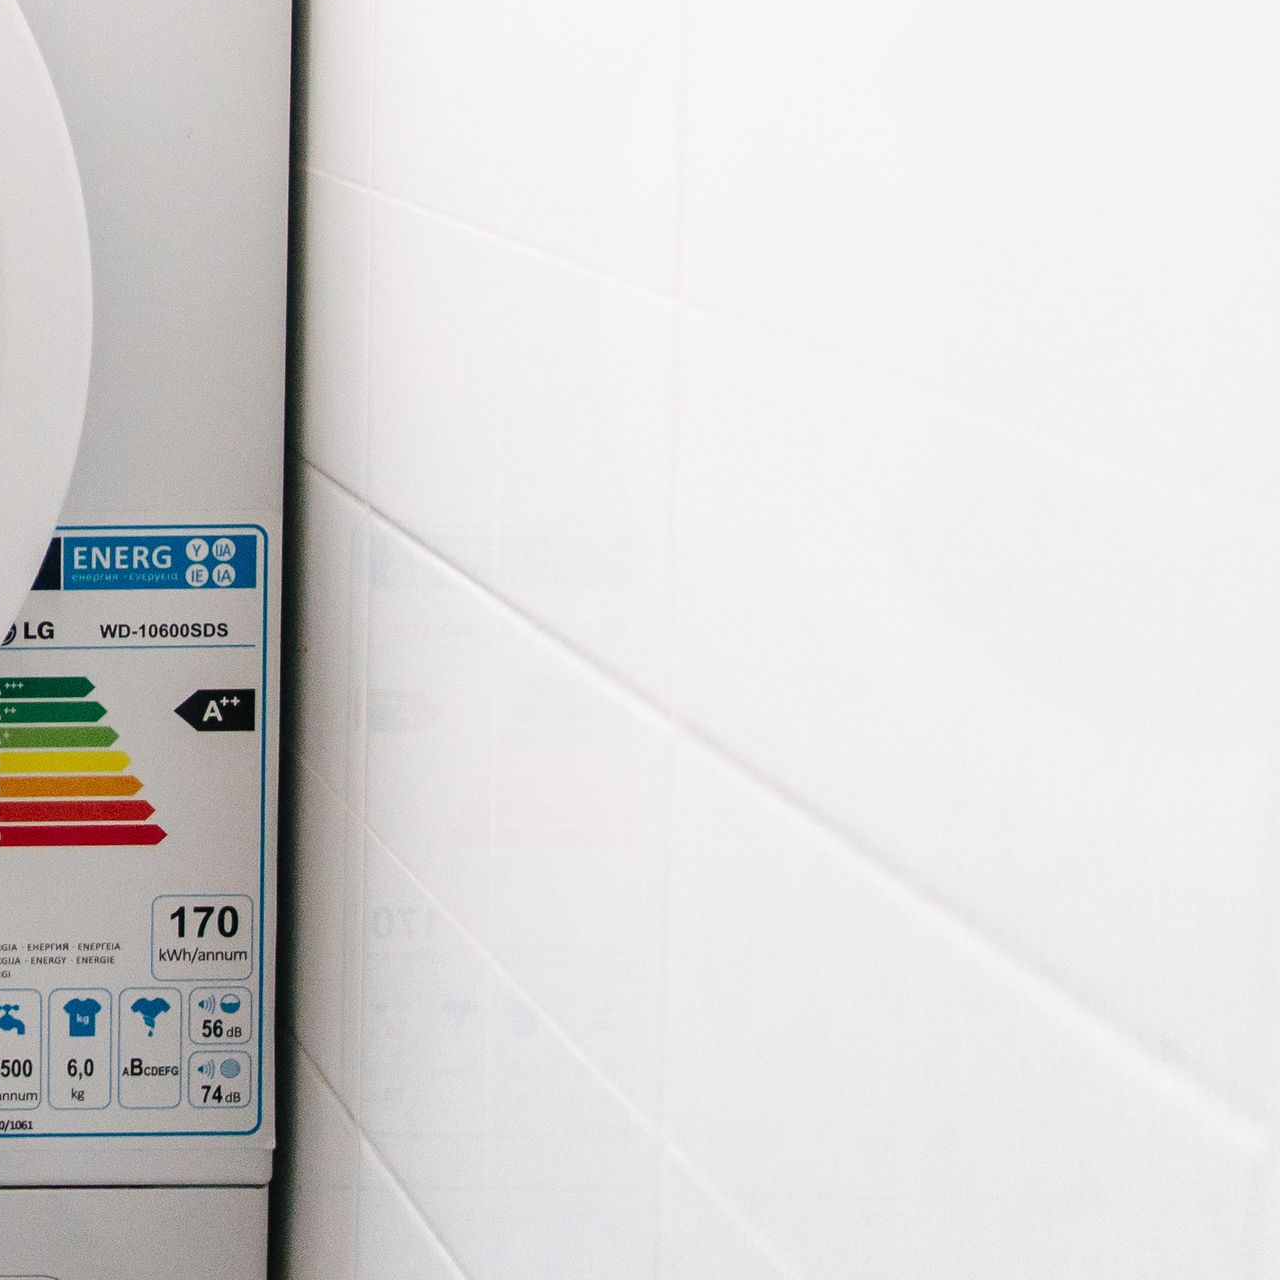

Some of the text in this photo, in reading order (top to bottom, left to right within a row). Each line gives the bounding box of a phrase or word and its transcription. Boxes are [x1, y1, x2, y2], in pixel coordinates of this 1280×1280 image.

[73, 545, 172, 570] ENERG
[192, 544, 202, 556] Y
[23, 621, 229, 640] LG WD-10600SDS
[202, 695, 241, 722] A++
[170, 905, 239, 938] 170
[30, 956, 66, 965] ENERGY
[76, 956, 115, 964] ENERGIE
[158, 947, 248, 963] kWh/annum
[76, 1014, 90, 1025] kg
[201, 1019, 242, 1038] 56 dB
[67, 1058, 94, 1081] 6,0
[122, 1057, 179, 1076] ABCDEFG
[71, 1088, 85, 1102] kg
[201, 1085, 241, 1104] 74 dB
